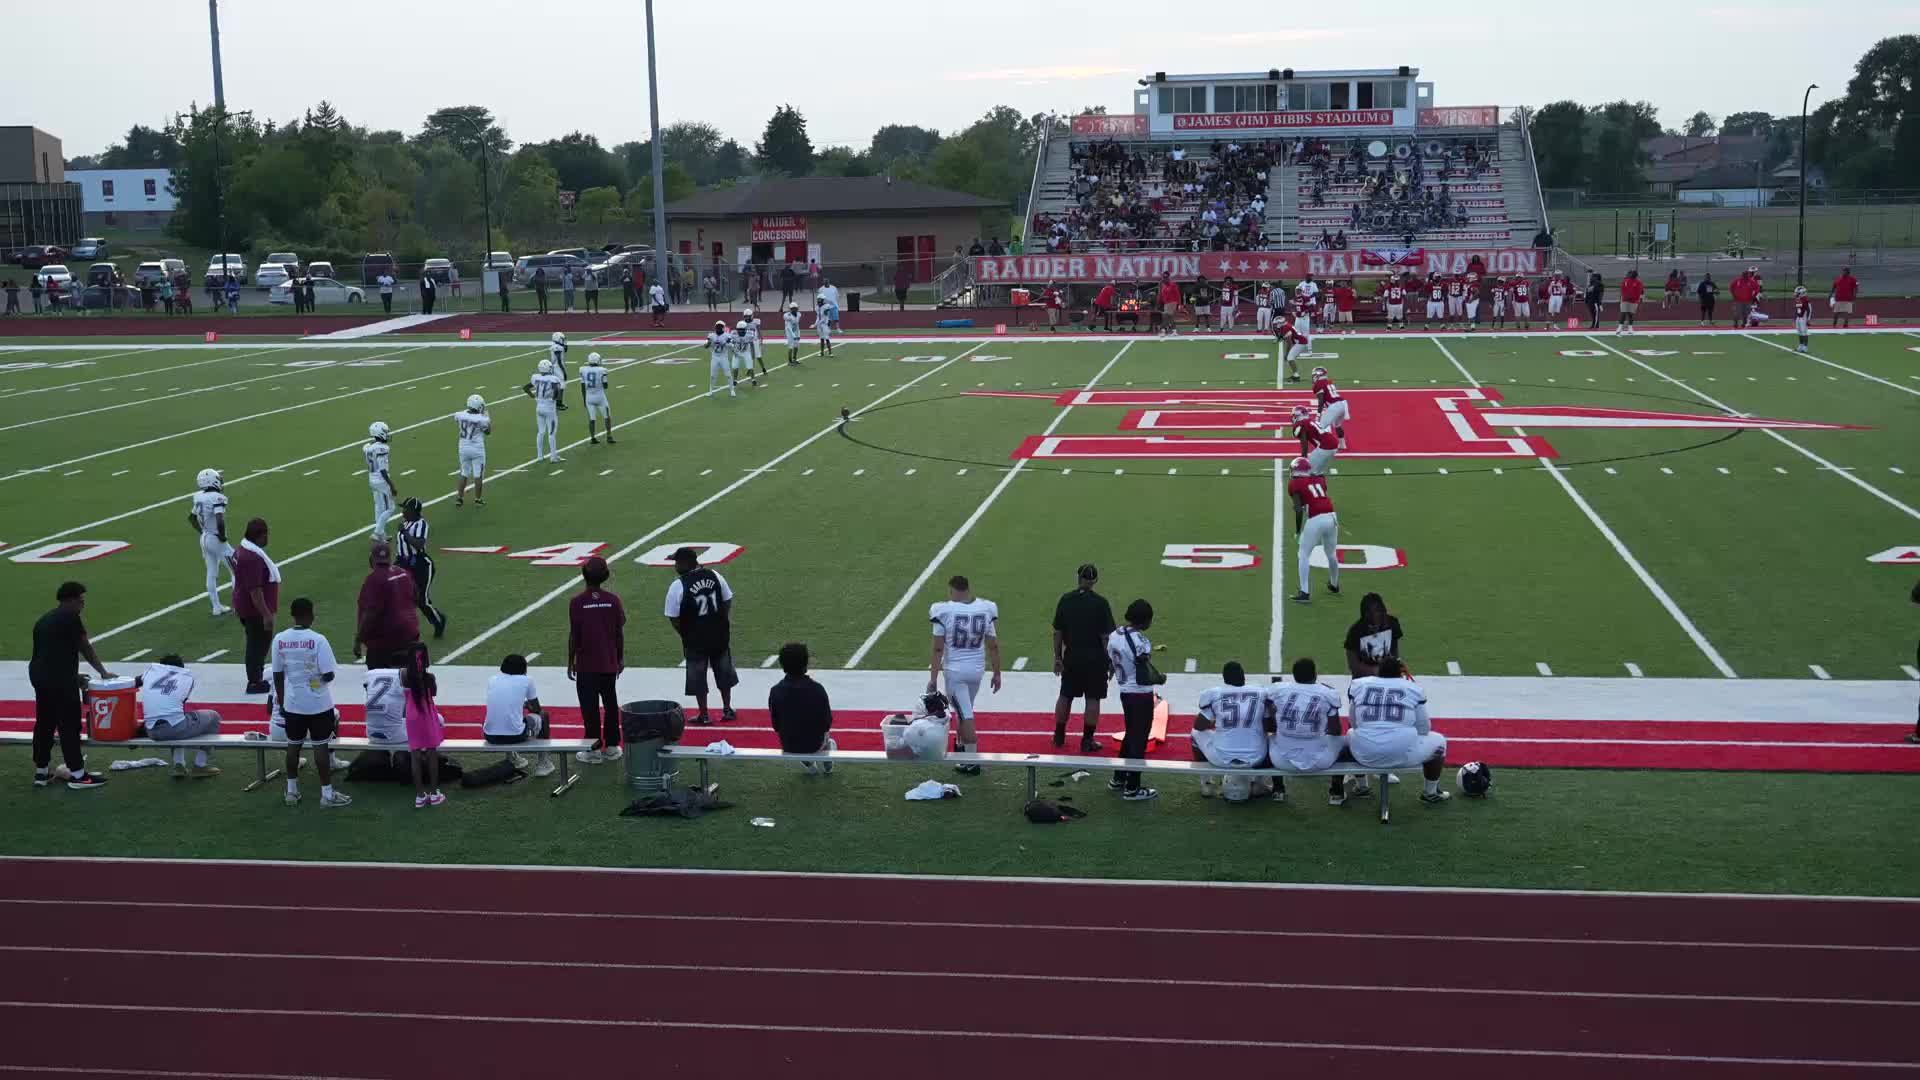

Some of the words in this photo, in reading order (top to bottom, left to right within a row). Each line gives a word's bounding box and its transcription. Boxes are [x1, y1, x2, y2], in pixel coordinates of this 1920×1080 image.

[1188, 115, 1232, 127] JAMES
[1235, 114, 1269, 128] (JIM)
[1273, 113, 1312, 125] BIBBS
[1316, 112, 1378, 124] STADIUM
[763, 216, 796, 228] RAIDER
[752, 230, 806, 241] CONCESSION
[981, 256, 1085, 280] RAIDER
[1095, 255, 1201, 278] NATION
[587, 372, 597, 389] 9
[1307, 483, 1326, 498] 11
[689, 579, 716, 594] GARNETT
[693, 590, 718, 617] 21
[952, 614, 987, 650] 69
[150, 671, 179, 696] 4
[366, 676, 394, 711] 2
[95, 699, 109, 716] G
[1219, 691, 1259, 729] 57
[1279, 695, 1321, 732] 44
